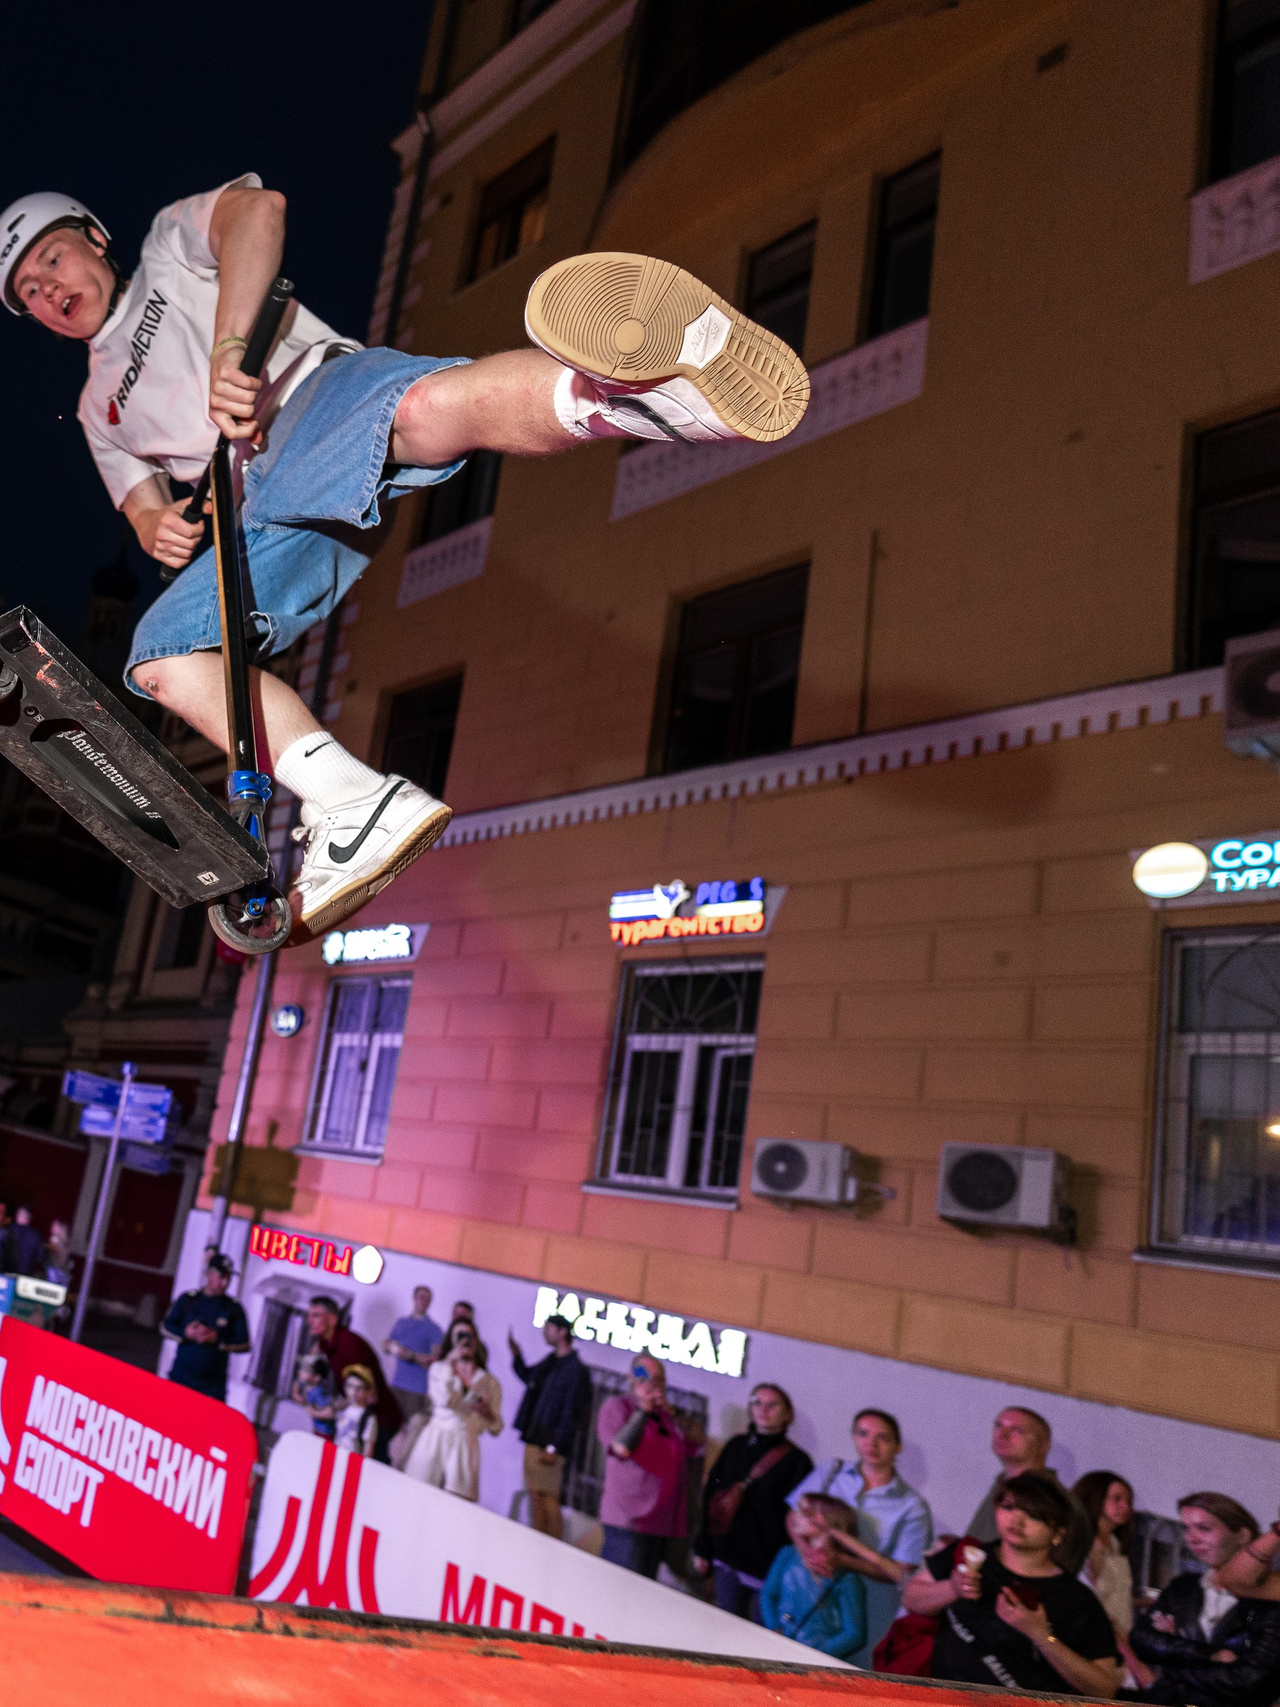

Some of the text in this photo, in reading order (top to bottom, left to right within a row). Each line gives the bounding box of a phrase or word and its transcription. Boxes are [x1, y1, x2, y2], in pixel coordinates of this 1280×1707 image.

[690, 320, 708, 351] NIKE
[710, 322, 719, 339] SB
[249, 1224, 352, 1276] ЦВЕТЫ
[13, 1430, 105, 1528] СПОРТ
[25, 1374, 227, 1540] МОСКОВСКИЙ
